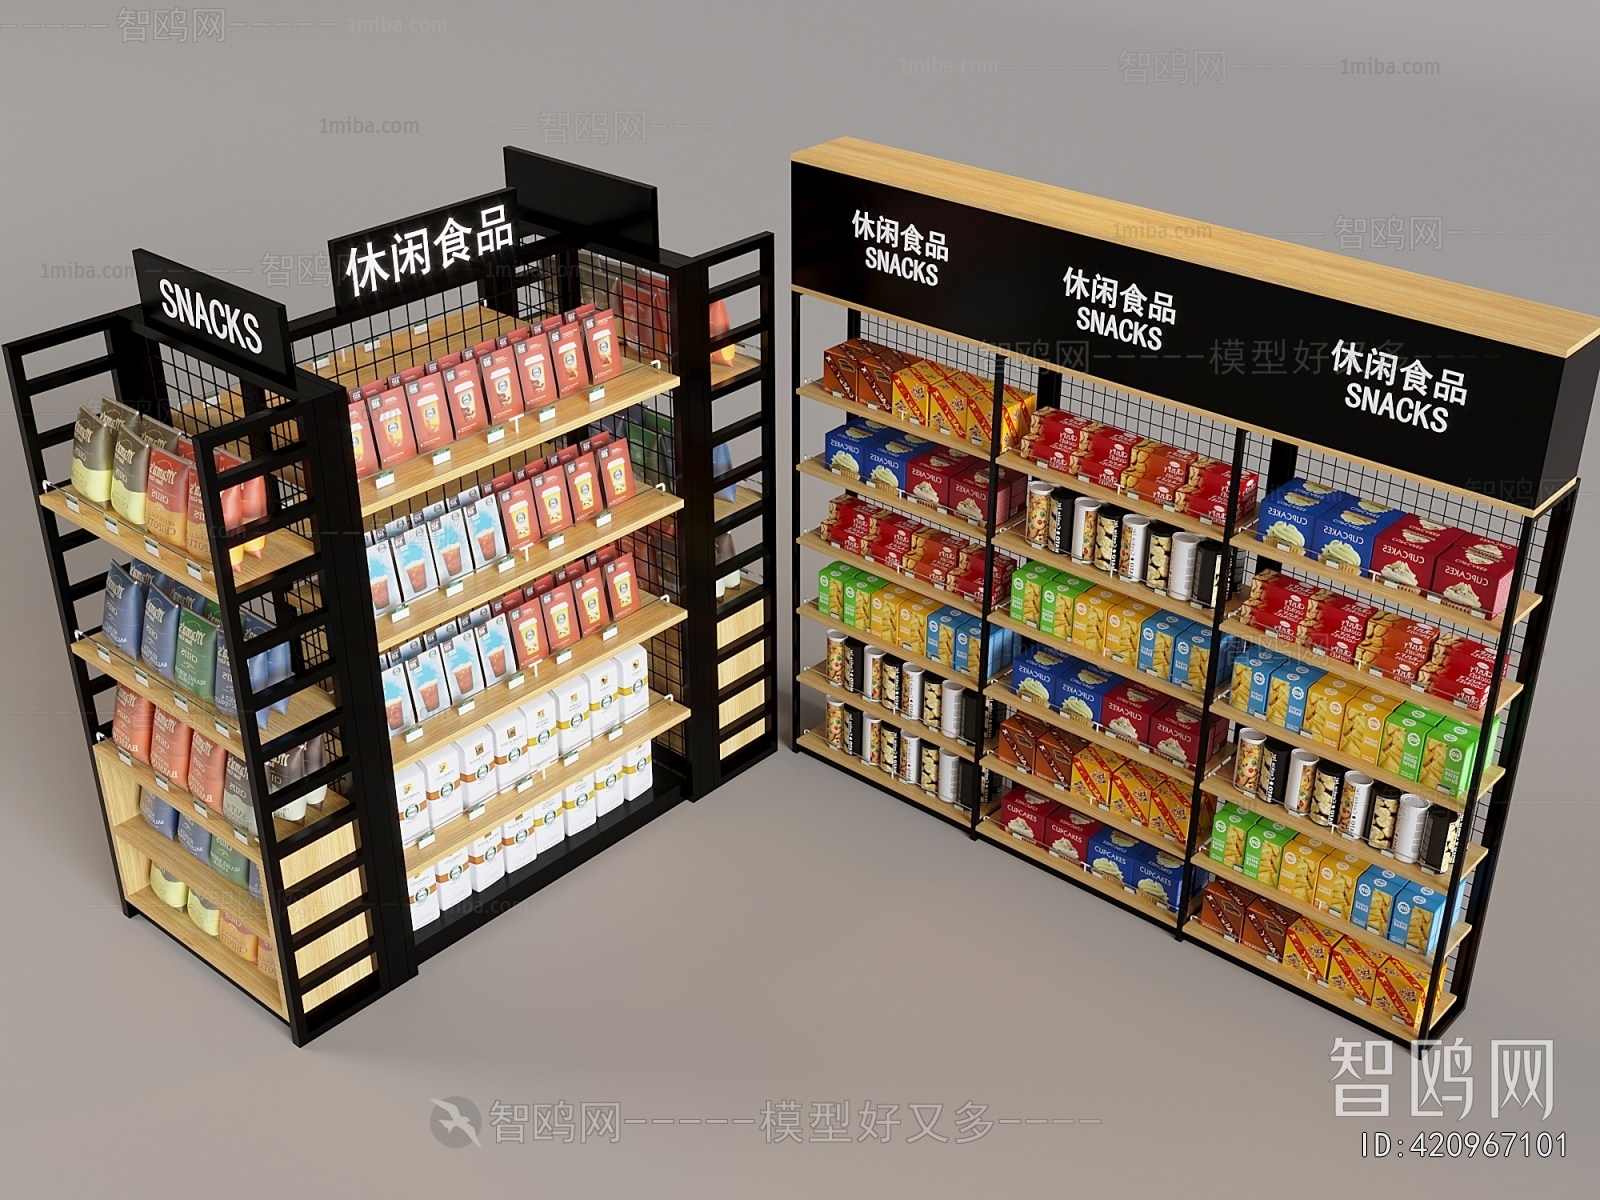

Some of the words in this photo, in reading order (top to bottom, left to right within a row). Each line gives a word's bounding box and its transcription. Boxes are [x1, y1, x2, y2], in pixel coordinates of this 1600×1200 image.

[346, 204, 513, 297] 休闲食品
[852, 210, 948, 261] 休闲食品
[866, 247, 938, 286] SNACKS
[160, 279, 262, 353] SNACKS
[1063, 267, 1175, 324] 休闲食品
[1077, 307, 1162, 350] SNACKS
[1332, 339, 1467, 405] 休闲食品
[1345, 383, 1448, 432] SNACKS
[1006, 803, 1038, 823] CUPCAKES
[1051, 824, 1083, 844] CUPCAKES
[1094, 845, 1127, 865] CUPCAKES
[1139, 866, 1172, 887] CUPCAKES
